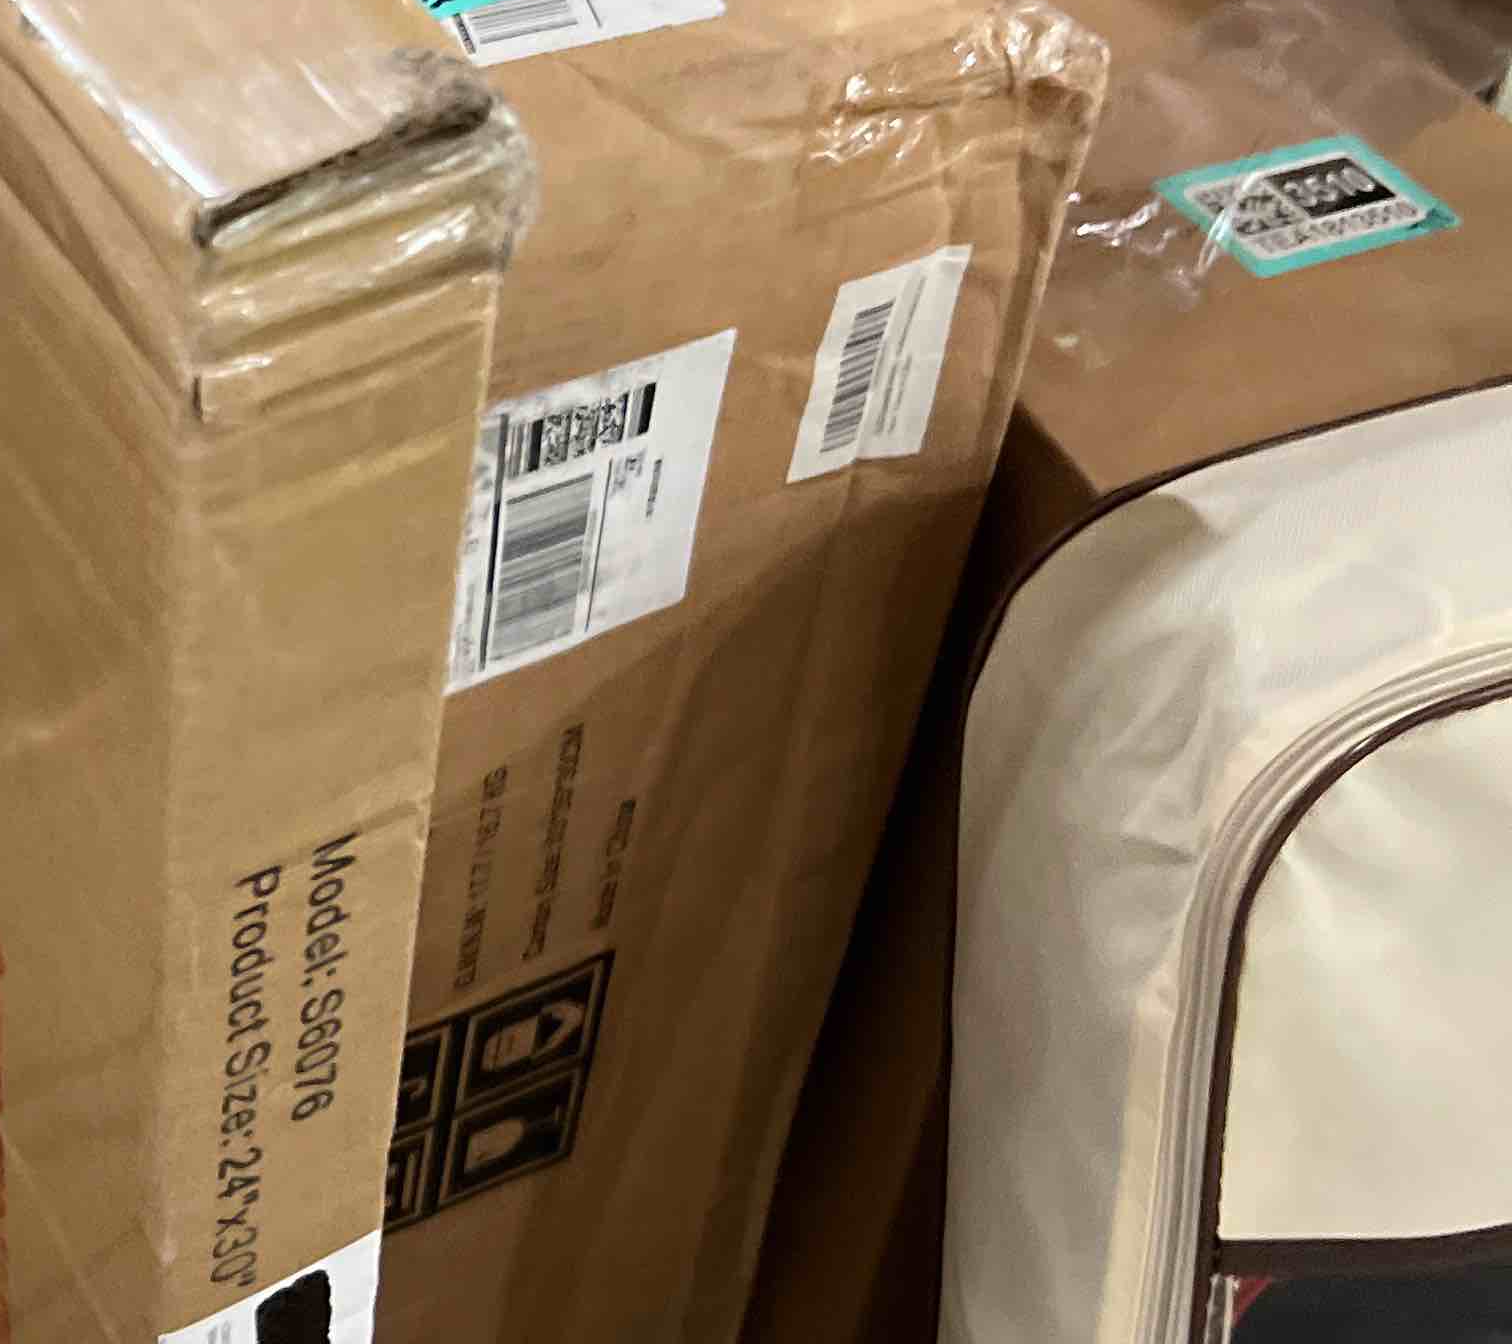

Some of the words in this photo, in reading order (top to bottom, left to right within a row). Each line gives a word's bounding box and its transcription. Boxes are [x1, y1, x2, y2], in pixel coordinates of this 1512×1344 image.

[224, 864, 283, 1044] Product
[219, 1040, 272, 1147] Size:
[291, 987, 345, 1122] S6076
[209, 1146, 263, 1288] 24"x30"
